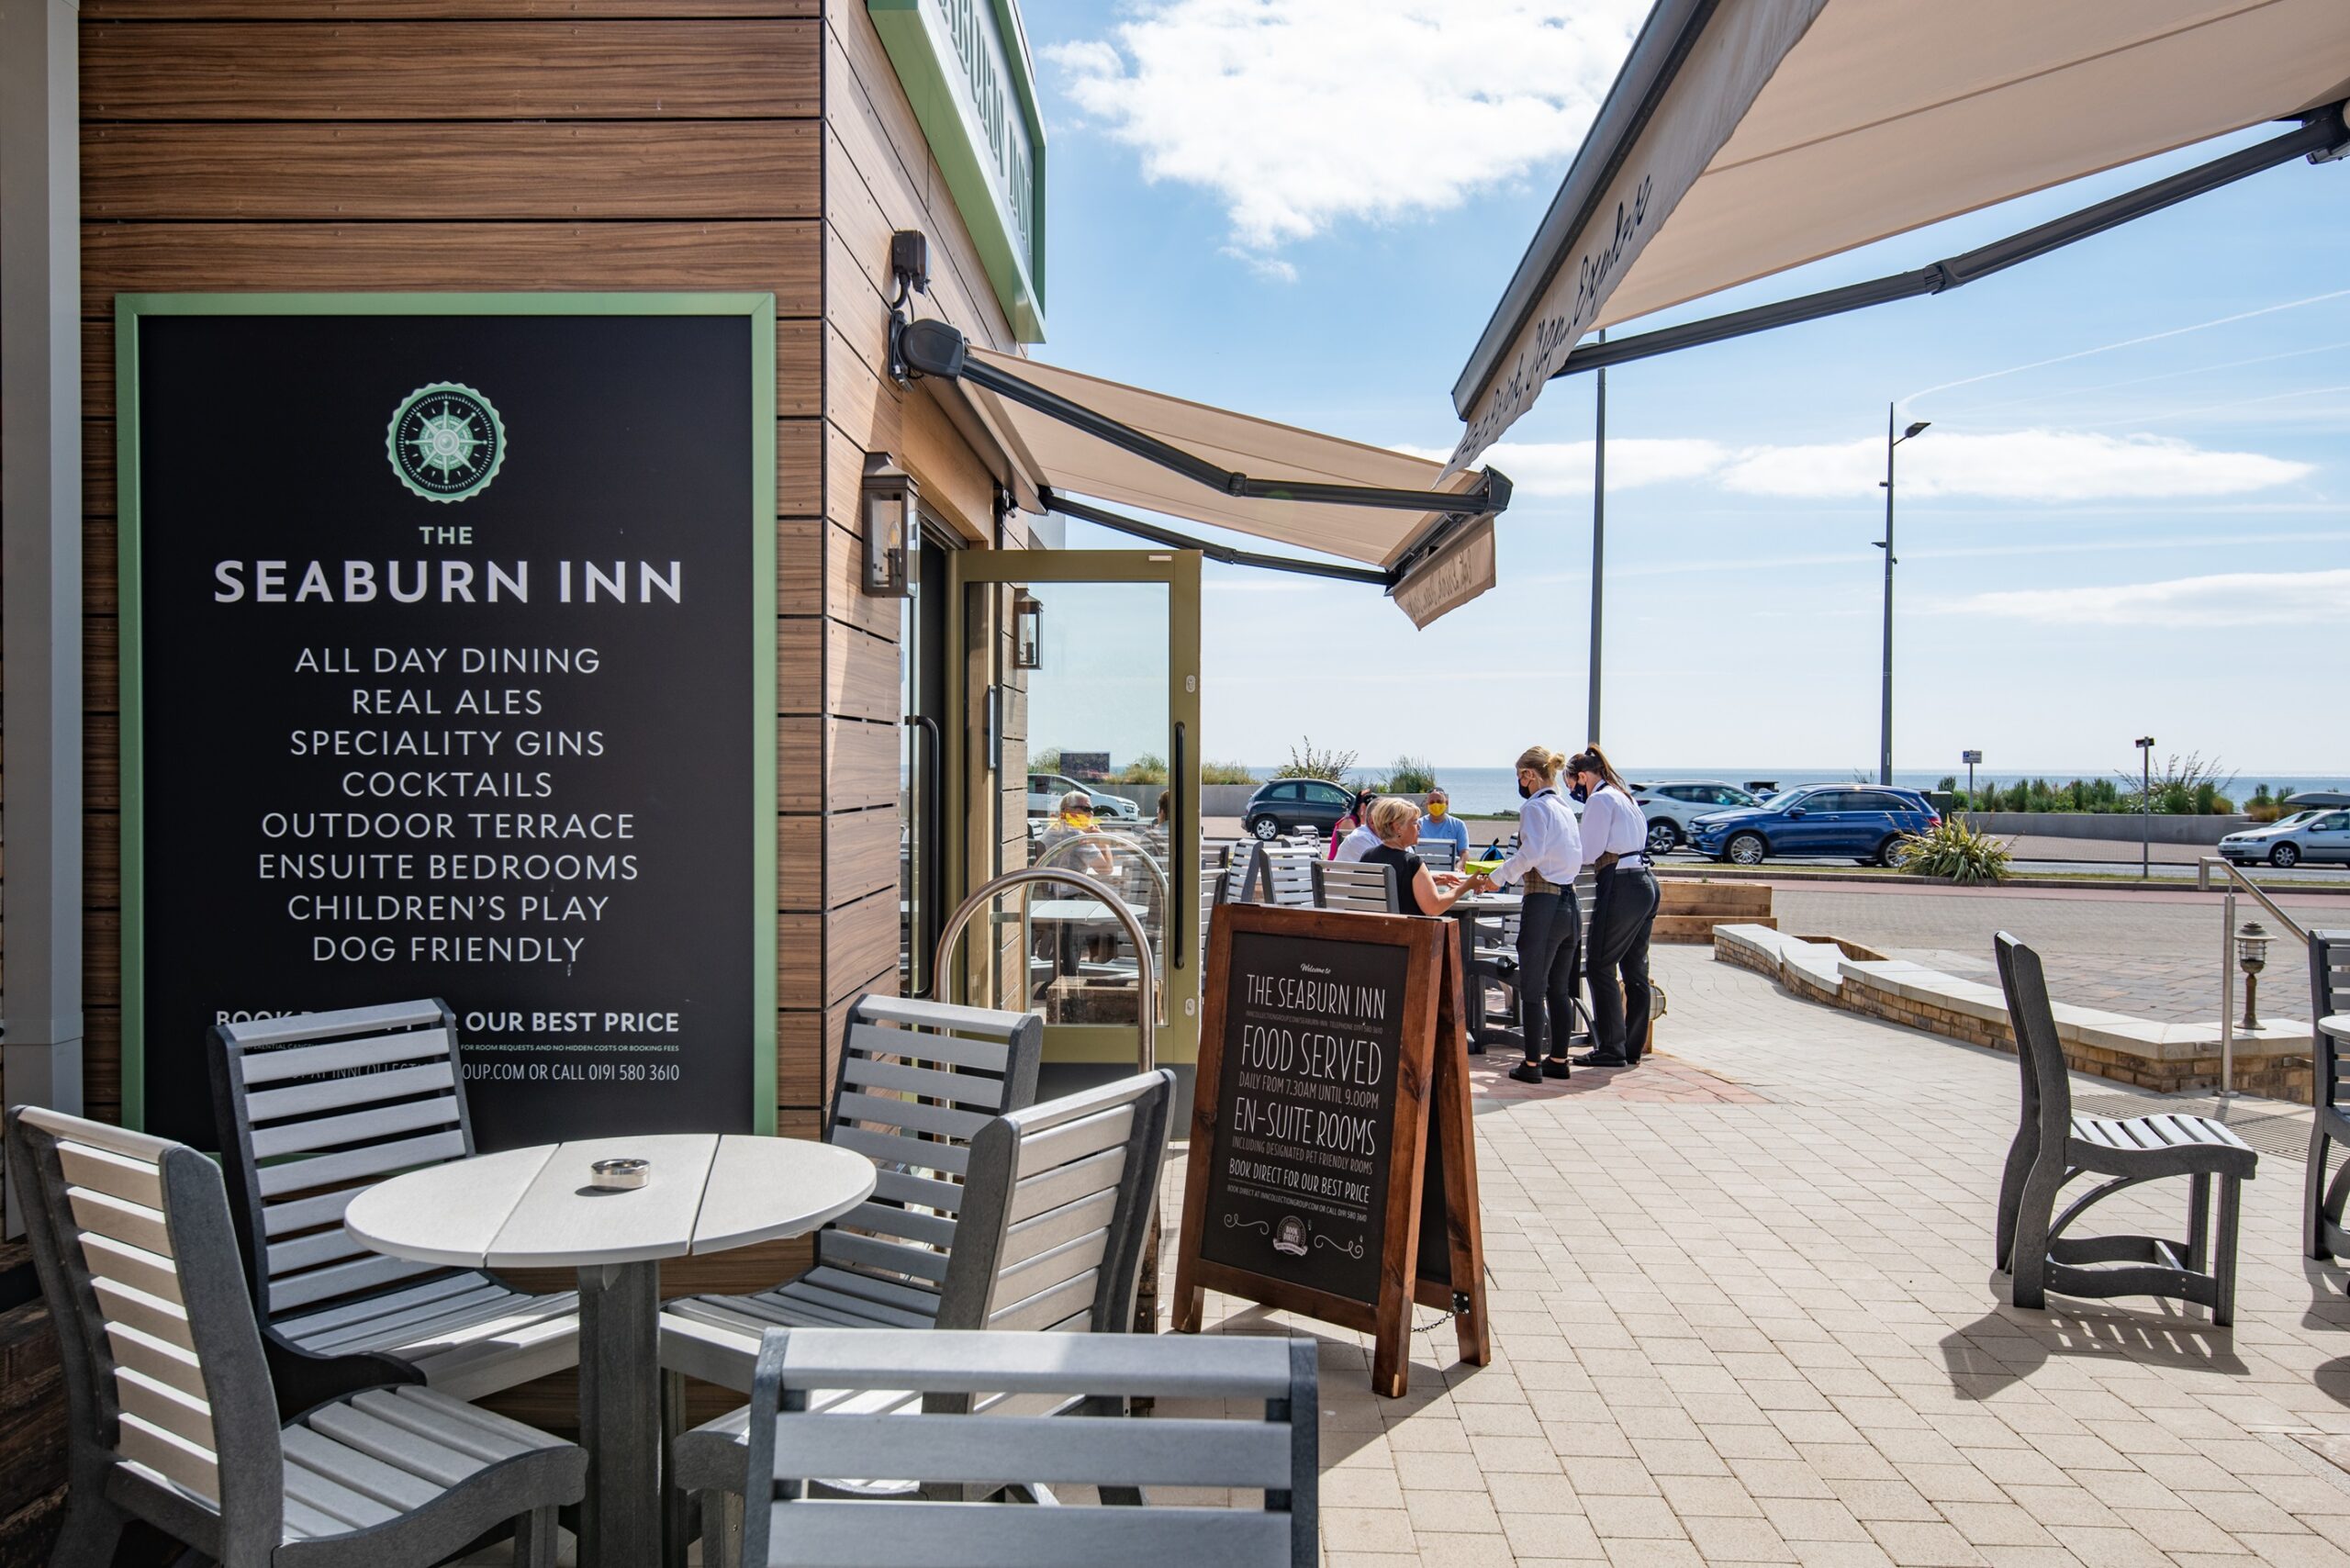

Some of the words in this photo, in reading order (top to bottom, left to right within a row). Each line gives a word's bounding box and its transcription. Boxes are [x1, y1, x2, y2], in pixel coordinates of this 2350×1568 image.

[1008, 120, 1032, 256] INN
[1572, 174, 1651, 324] Explore
[420, 527, 473, 545] THE
[215, 560, 529, 603] SEABURN
[560, 560, 681, 604] INN
[295, 647, 360, 673] ALL
[375, 647, 448, 673] DAY
[462, 647, 599, 674] DINING
[352, 689, 442, 714] REAL
[454, 689, 543, 715] ALES
[290, 730, 502, 756] SPECIALITY
[515, 730, 604, 756] GINS
[342, 771, 553, 798] COCKTAILS
[262, 812, 455, 839] OUTDOOR
[467, 813, 634, 839] TERRACE
[260, 854, 414, 879] ENSUITE
[430, 854, 638, 880] BEDROOMS
[521, 895, 610, 922] PLAY
[314, 935, 396, 962] DOG
[411, 936, 585, 962] FRIENDLY
[1300, 963, 1325, 974] Welcome
[1247, 974, 1273, 1005] THE
[1278, 978, 1349, 1014] SEABURN
[1356, 987, 1384, 1019] INN
[465, 1012, 525, 1032] OUR
[532, 1012, 598, 1032] BEST
[604, 1012, 679, 1033] PRICE
[498, 1044, 534, 1052] REQUESTS
[1242, 1025, 1292, 1071] FOOD
[1300, 1033, 1381, 1085] SERVED
[529, 1063, 549, 1081] OR
[552, 1064, 586, 1081] CALL
[588, 1064, 615, 1081] 0191
[619, 1064, 645, 1081] 580
[649, 1064, 680, 1081] 3610
[1239, 1071, 1260, 1089] DAILY
[1262, 1075, 1283, 1093] FROM
[1286, 1080, 1316, 1099] 7.30AM
[1318, 1084, 1342, 1103] UNTIL
[1346, 1089, 1379, 1109] 9.00PM
[1235, 1097, 1313, 1143] EN-SUITE
[1316, 1111, 1376, 1155] ROOMS
[1233, 1136, 1265, 1153] INCLUDING
[1267, 1142, 1304, 1160] DESIGNATED
[1305, 1149, 1317, 1163] PET
[1319, 1152, 1348, 1170] FRIENDLY
[1350, 1159, 1372, 1175] ROOMS
[1227, 1184, 1240, 1193] BOOK
[1240, 1187, 1254, 1195] DIRECT
[1229, 1158, 1251, 1177] BOOK
[1253, 1163, 1281, 1183] DIRECT
[1284, 1170, 1299, 1188] FOR
[1302, 1173, 1318, 1192] OUR
[1322, 1177, 1343, 1196] BEST
[1345, 1182, 1370, 1203] PRICE
